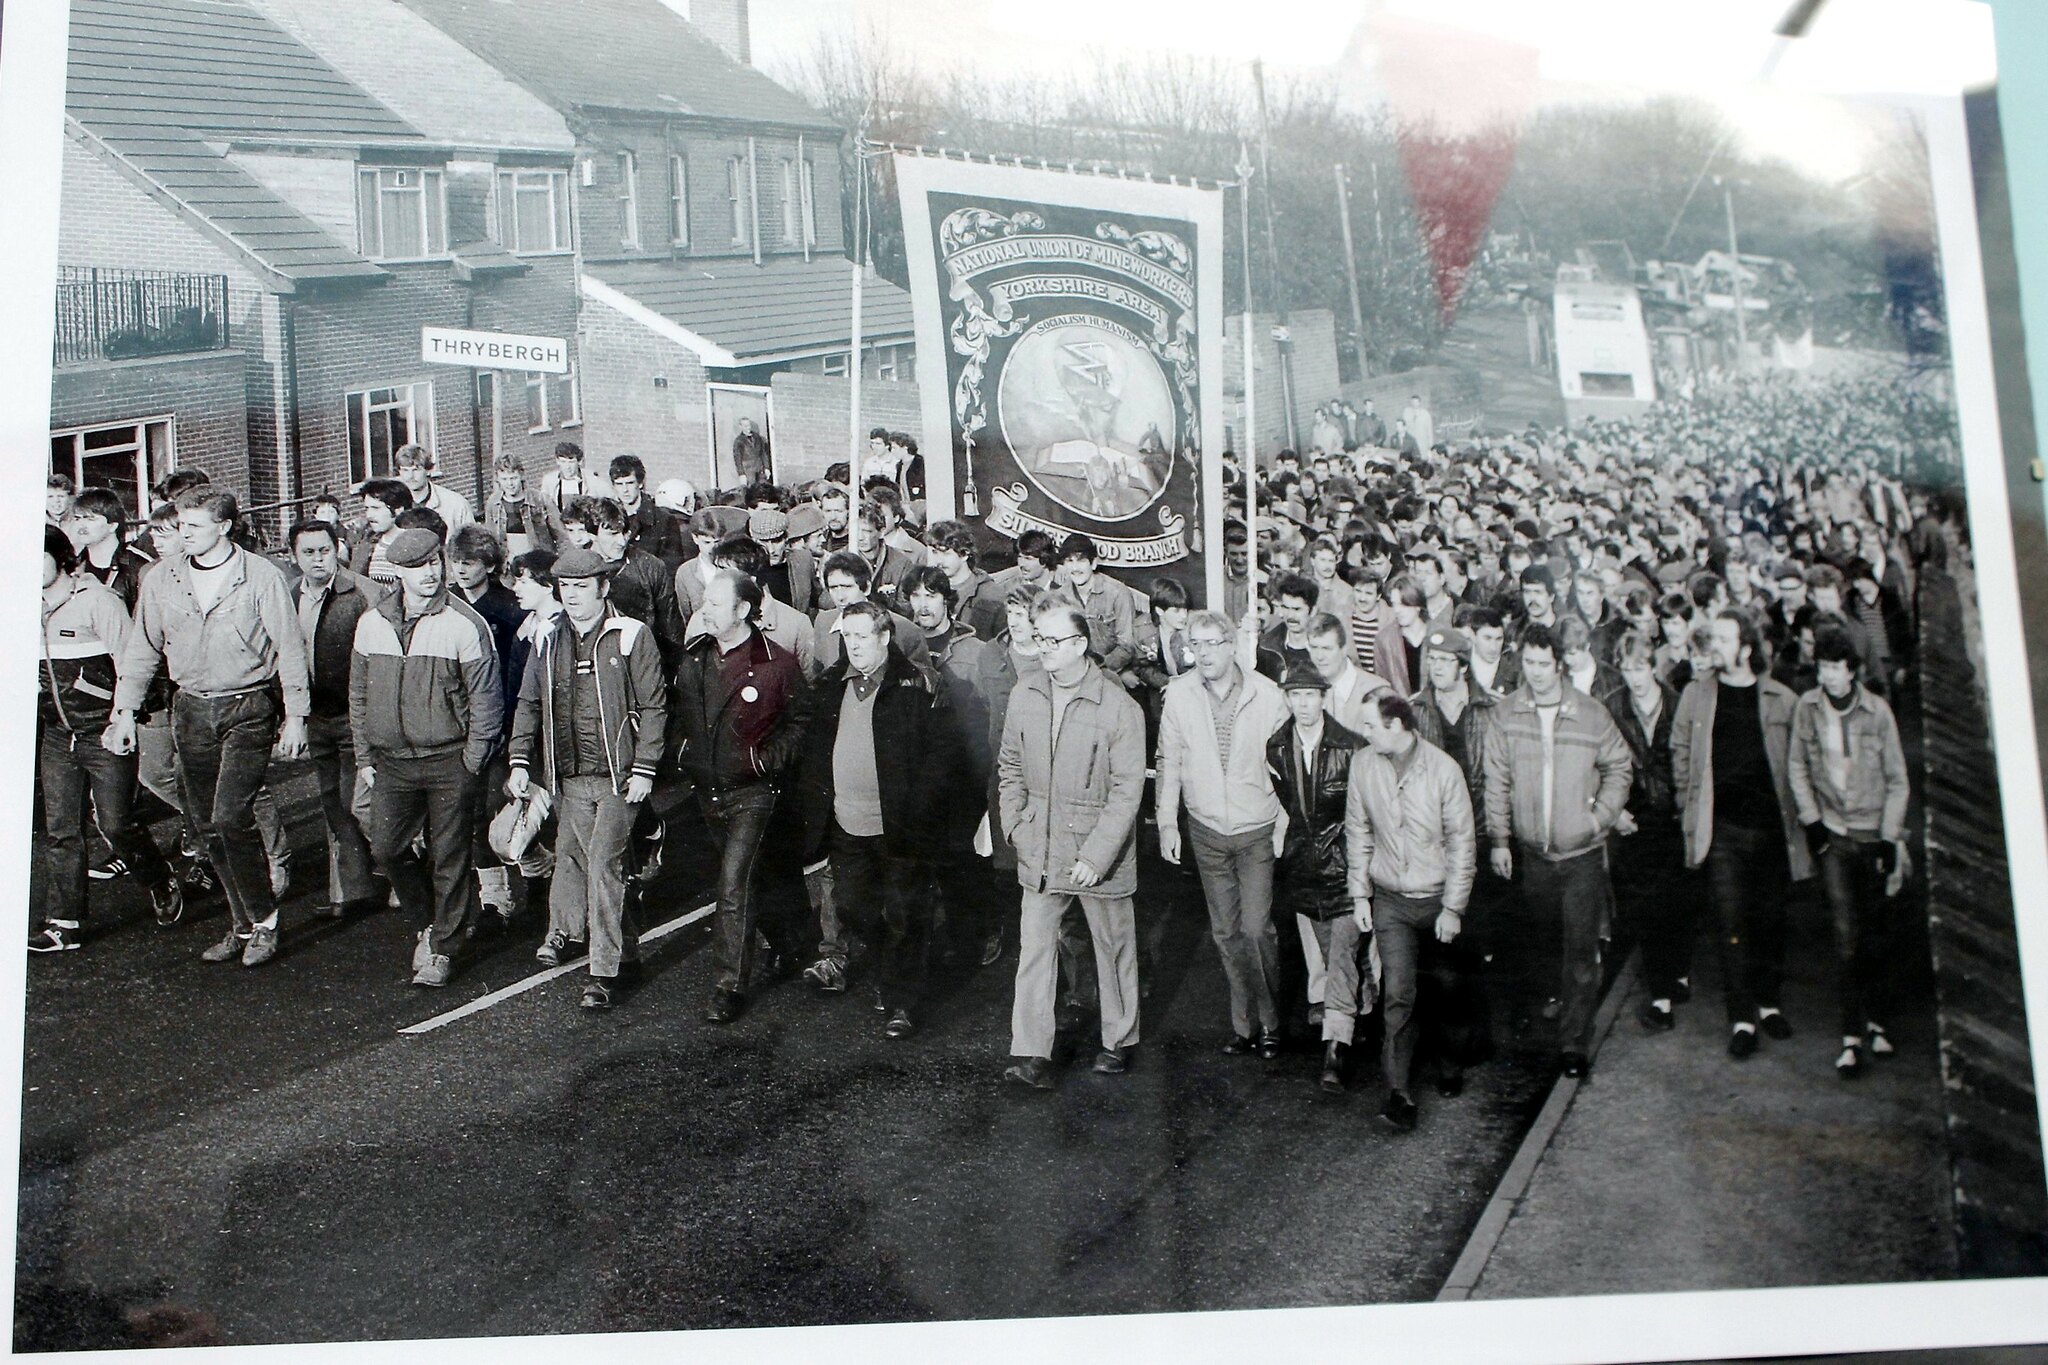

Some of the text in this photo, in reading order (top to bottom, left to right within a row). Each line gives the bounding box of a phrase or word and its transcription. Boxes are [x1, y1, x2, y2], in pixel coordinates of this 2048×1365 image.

[953, 241, 1194, 308] NATIONAL UNION OF MINEWORKERS
[1002, 278, 1162, 323] YORKSHIRE AREA
[1036, 315, 1139, 346] SOCIALISM HUMANISM
[431, 338, 560, 363] THRYBERGH
[1125, 538, 1181, 562] BRANCH
